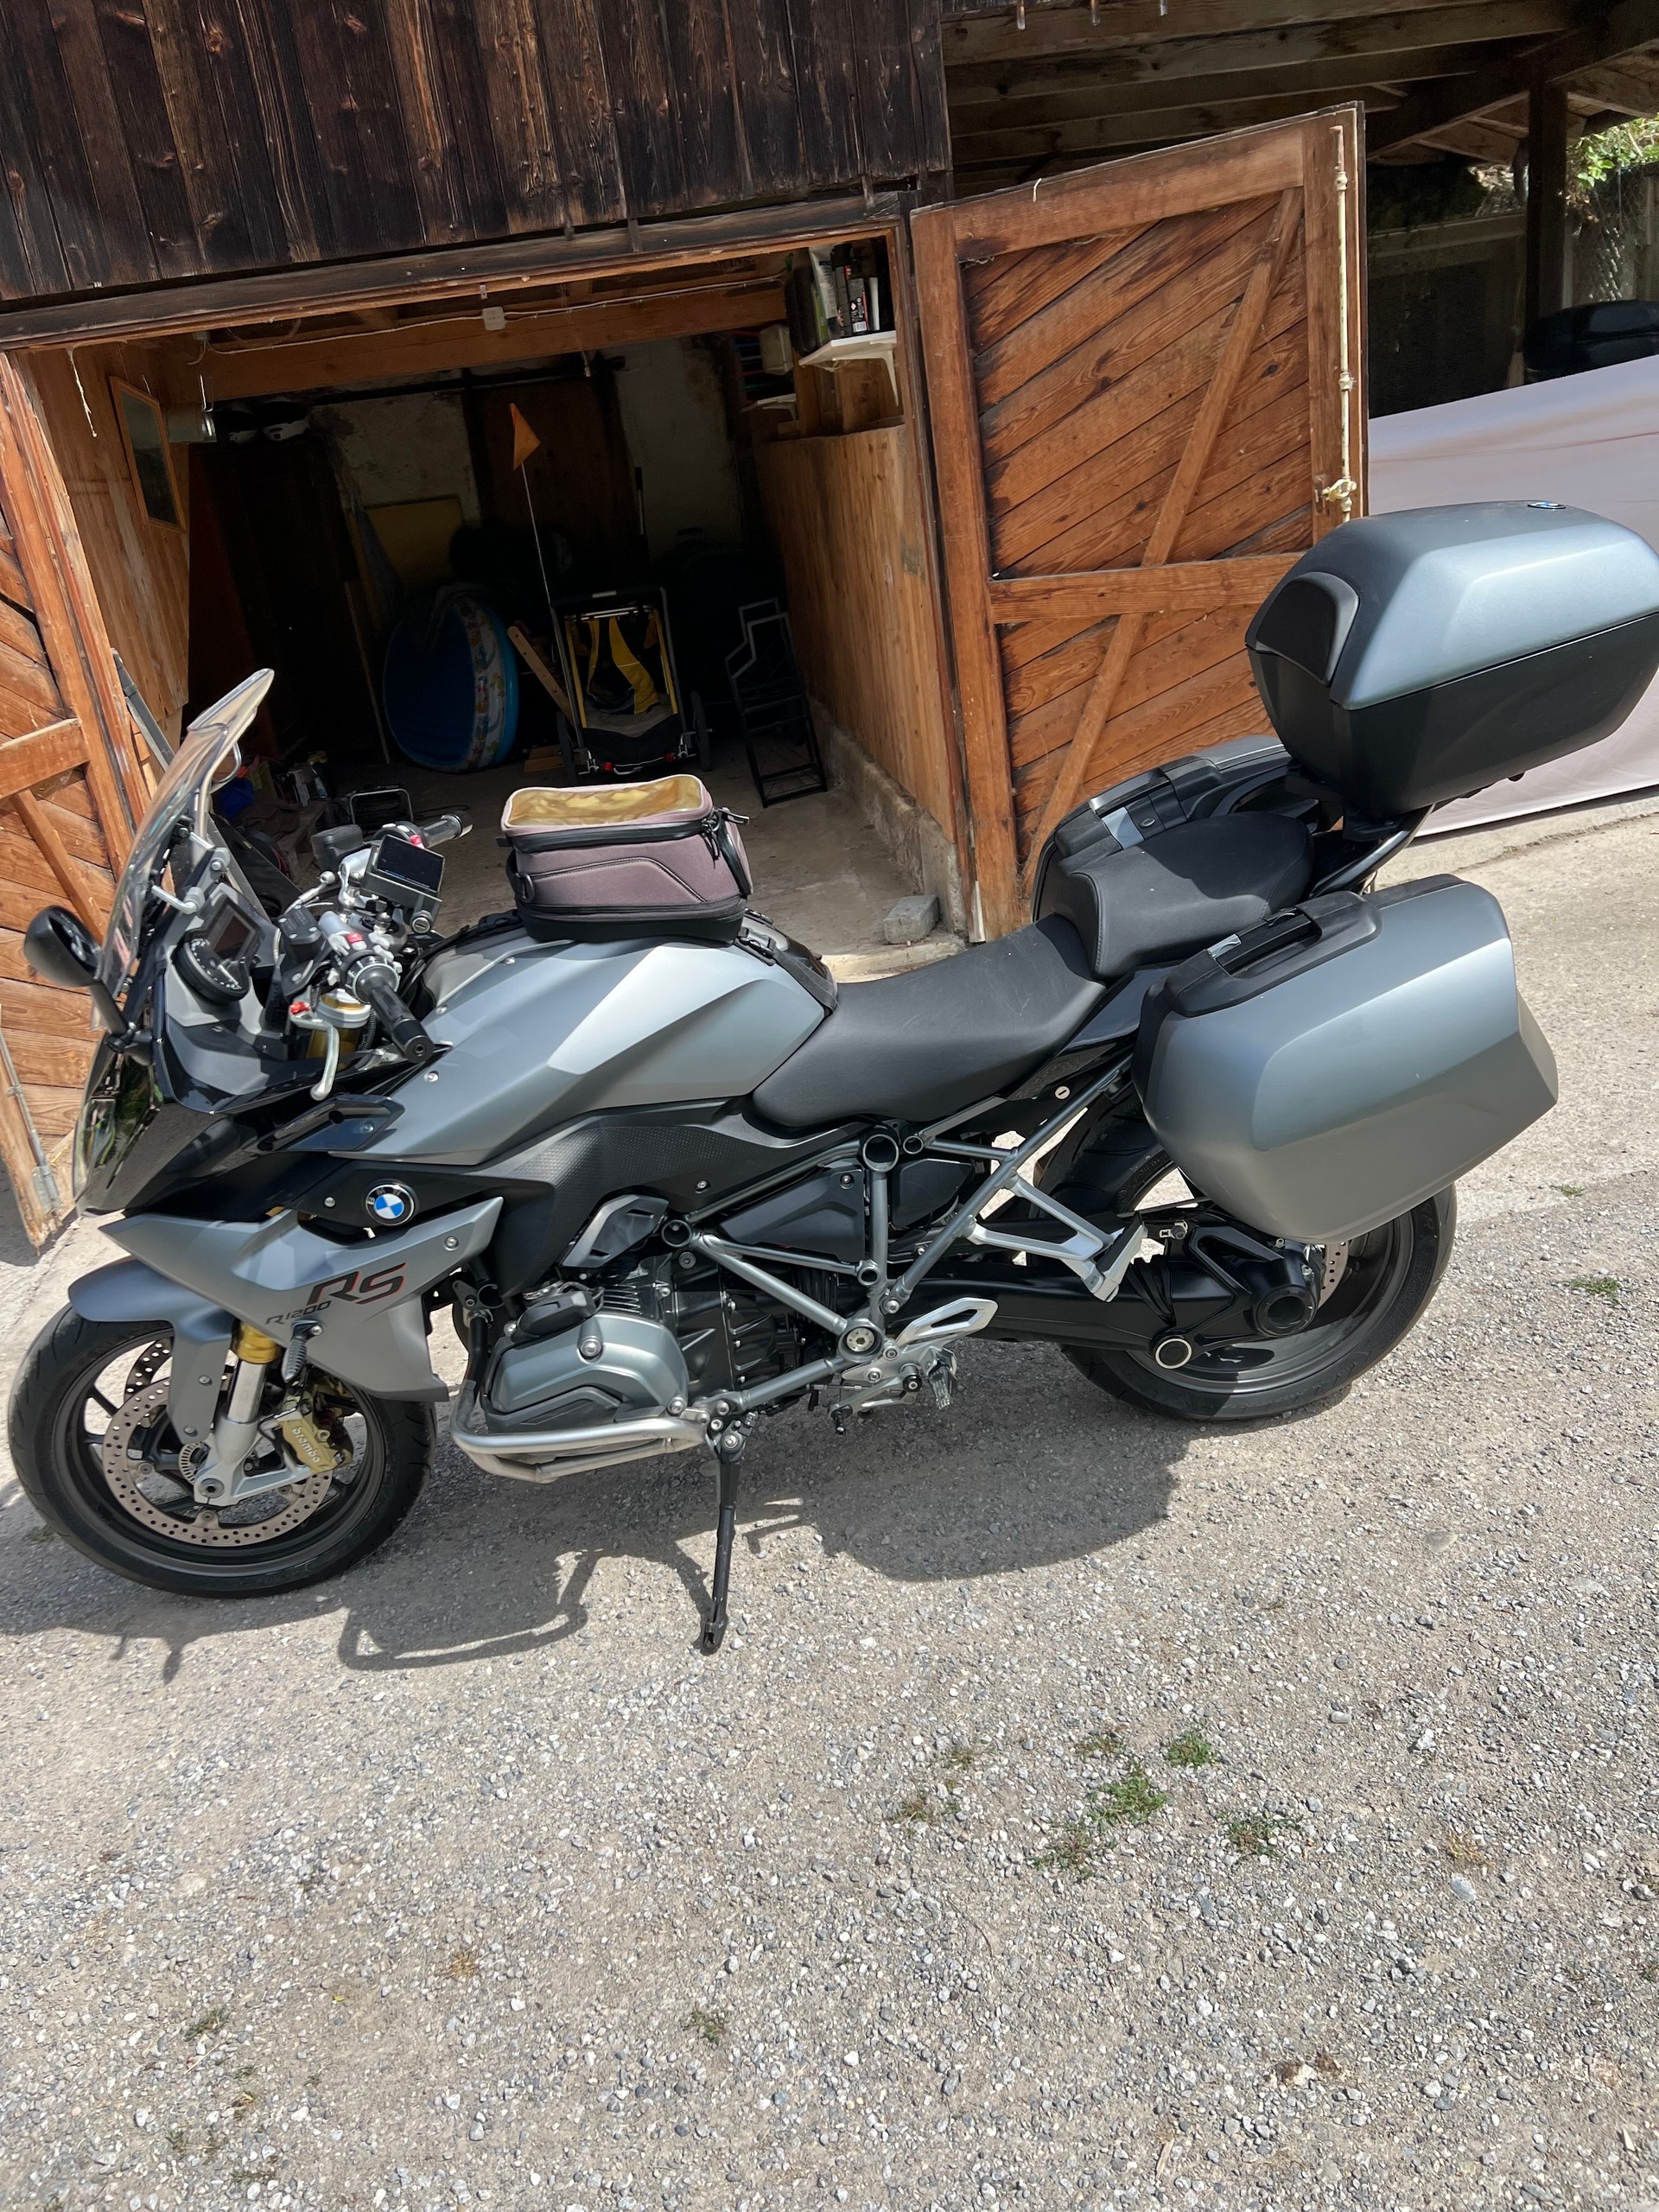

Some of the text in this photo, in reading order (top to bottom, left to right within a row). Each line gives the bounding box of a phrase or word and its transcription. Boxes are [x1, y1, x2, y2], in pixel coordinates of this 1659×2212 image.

[367, 1186, 402, 1205] BMW
[306, 1262, 408, 1306] RS
[264, 1300, 333, 1325] R1200
[292, 1426, 321, 1463] brembo
